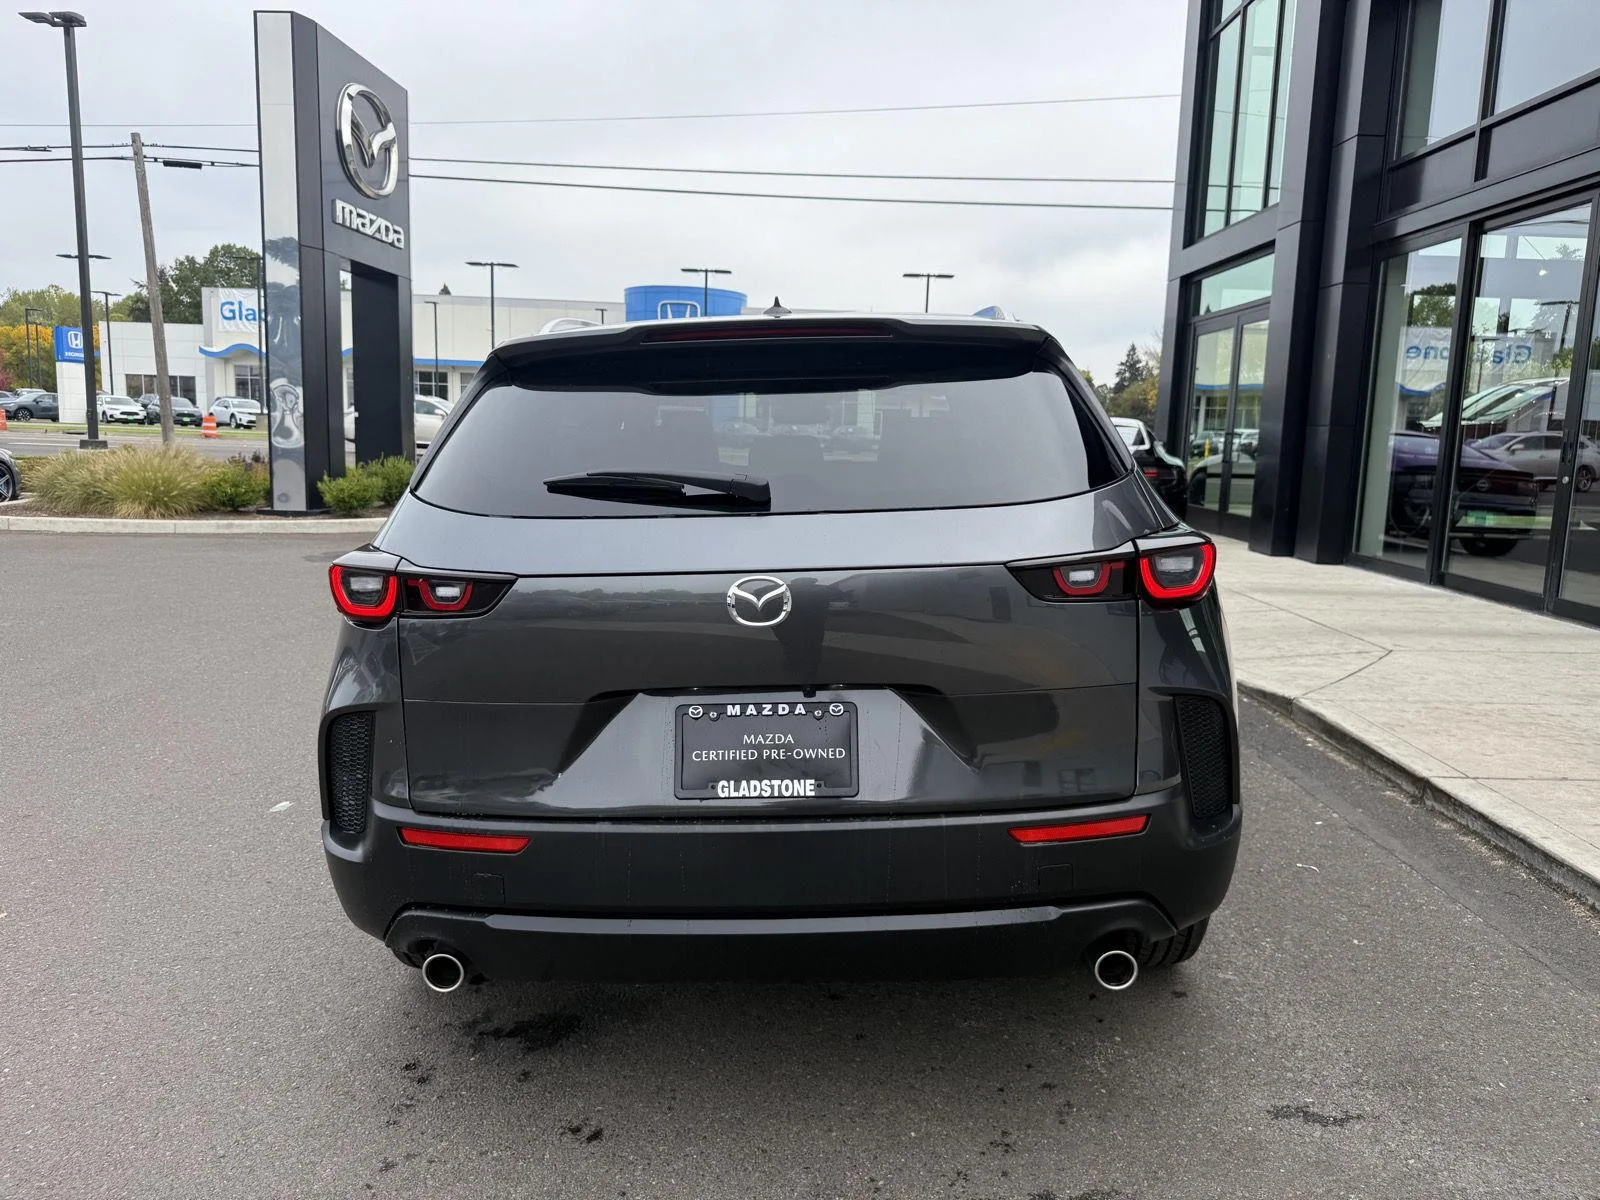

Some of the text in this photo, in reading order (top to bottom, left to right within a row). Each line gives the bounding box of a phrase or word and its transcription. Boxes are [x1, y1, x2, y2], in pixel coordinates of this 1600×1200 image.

[335, 198, 405, 249] mazda
[220, 300, 264, 322] Gla
[726, 703, 807, 716] MAZDA
[742, 733, 795, 745] MAZDA
[691, 748, 846, 762] CERTIFIED PRE-OWNED
[717, 779, 816, 798] GLADSTONE
